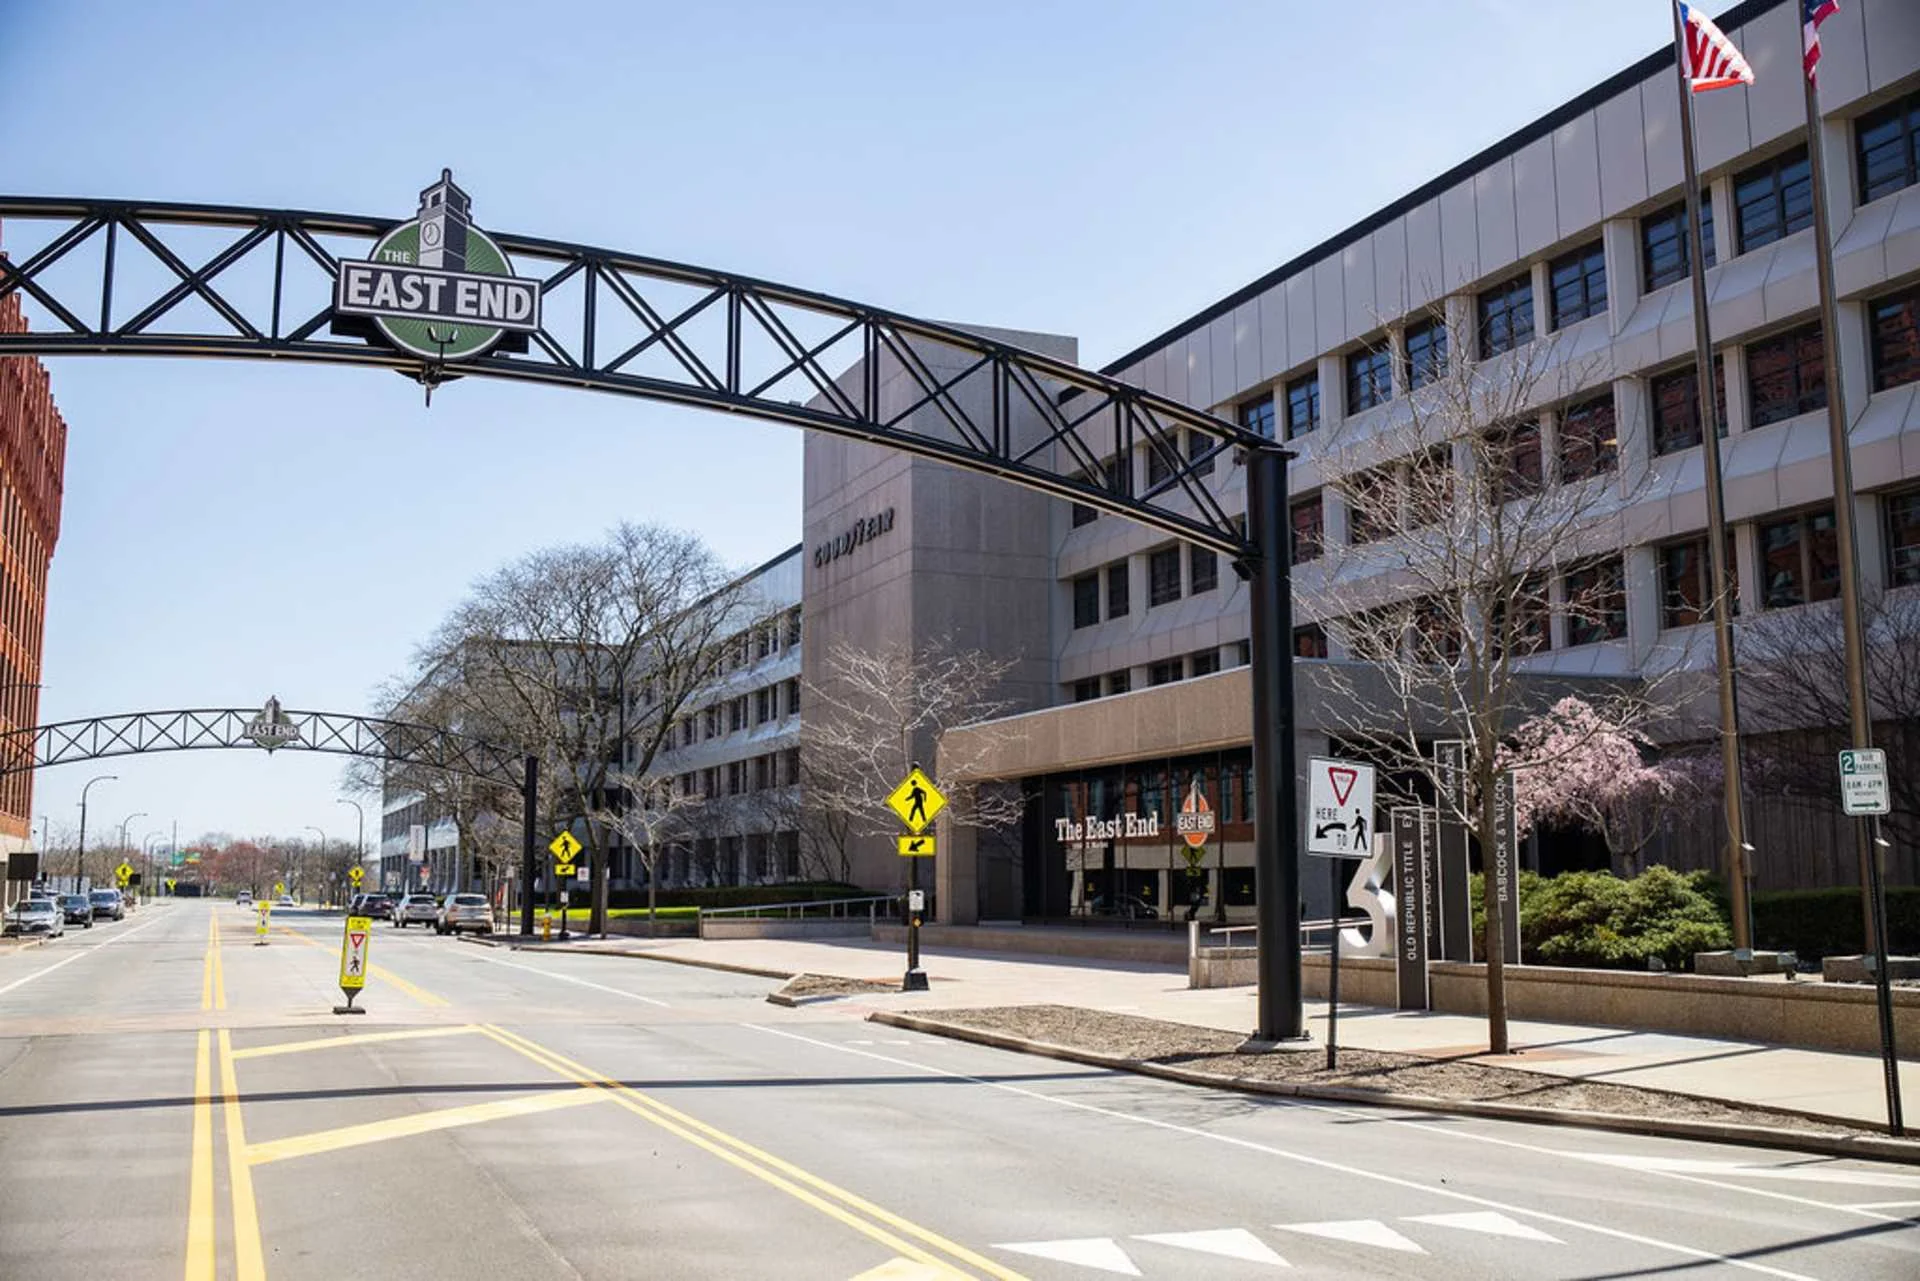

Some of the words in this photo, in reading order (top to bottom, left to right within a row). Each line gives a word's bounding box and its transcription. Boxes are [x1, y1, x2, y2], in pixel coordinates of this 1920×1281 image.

[384, 249, 410, 264] THE
[347, 269, 447, 312] EAST
[455, 280, 532, 321] END
[247, 724, 272, 736] EAST
[275, 725, 297, 738] END
[1843, 755, 1853, 771] 2
[1494, 775, 1506, 823] WILCOX
[1315, 807, 1338, 820] HERE
[1402, 813, 1413, 828] EY
[1055, 817, 1083, 842] The
[1085, 813, 1123, 840] East
[1125, 810, 1159, 837] End
[1178, 816, 1197, 831] EAST
[1337, 833, 1348, 847] TO
[1497, 828, 1506, 836] &
[1403, 841, 1413, 873] TITLE
[1496, 841, 1508, 901] BABCOCK
[1404, 877, 1416, 931] REPUBLIC
[1407, 936, 1417, 961] OLD
